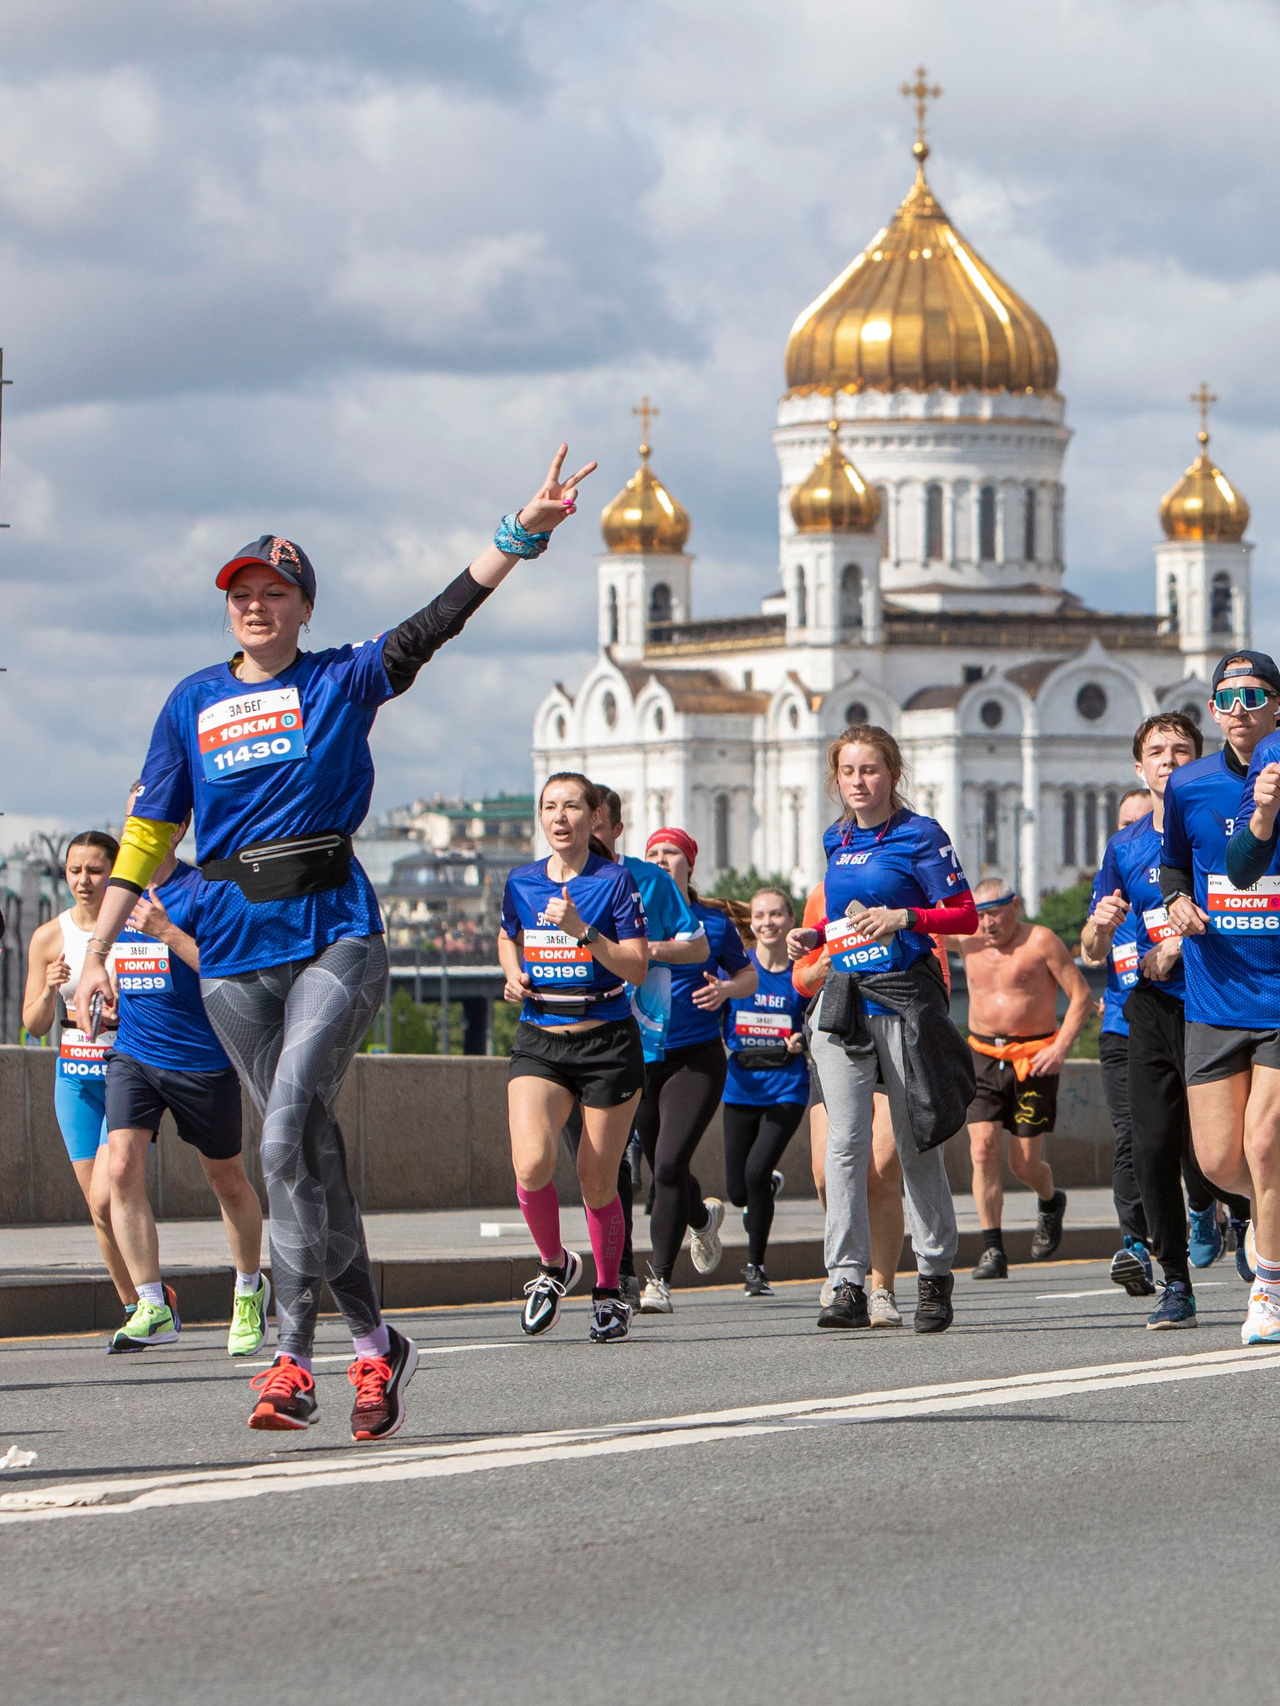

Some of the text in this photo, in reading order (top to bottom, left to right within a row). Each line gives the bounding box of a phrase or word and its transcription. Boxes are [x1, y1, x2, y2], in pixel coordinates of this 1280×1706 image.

[213, 737, 291, 771] 11430
[1213, 915, 1280, 930] 10586
[841, 945, 889, 968] 11921
[532, 965, 588, 978] 03196
[119, 977, 166, 990] 13239
